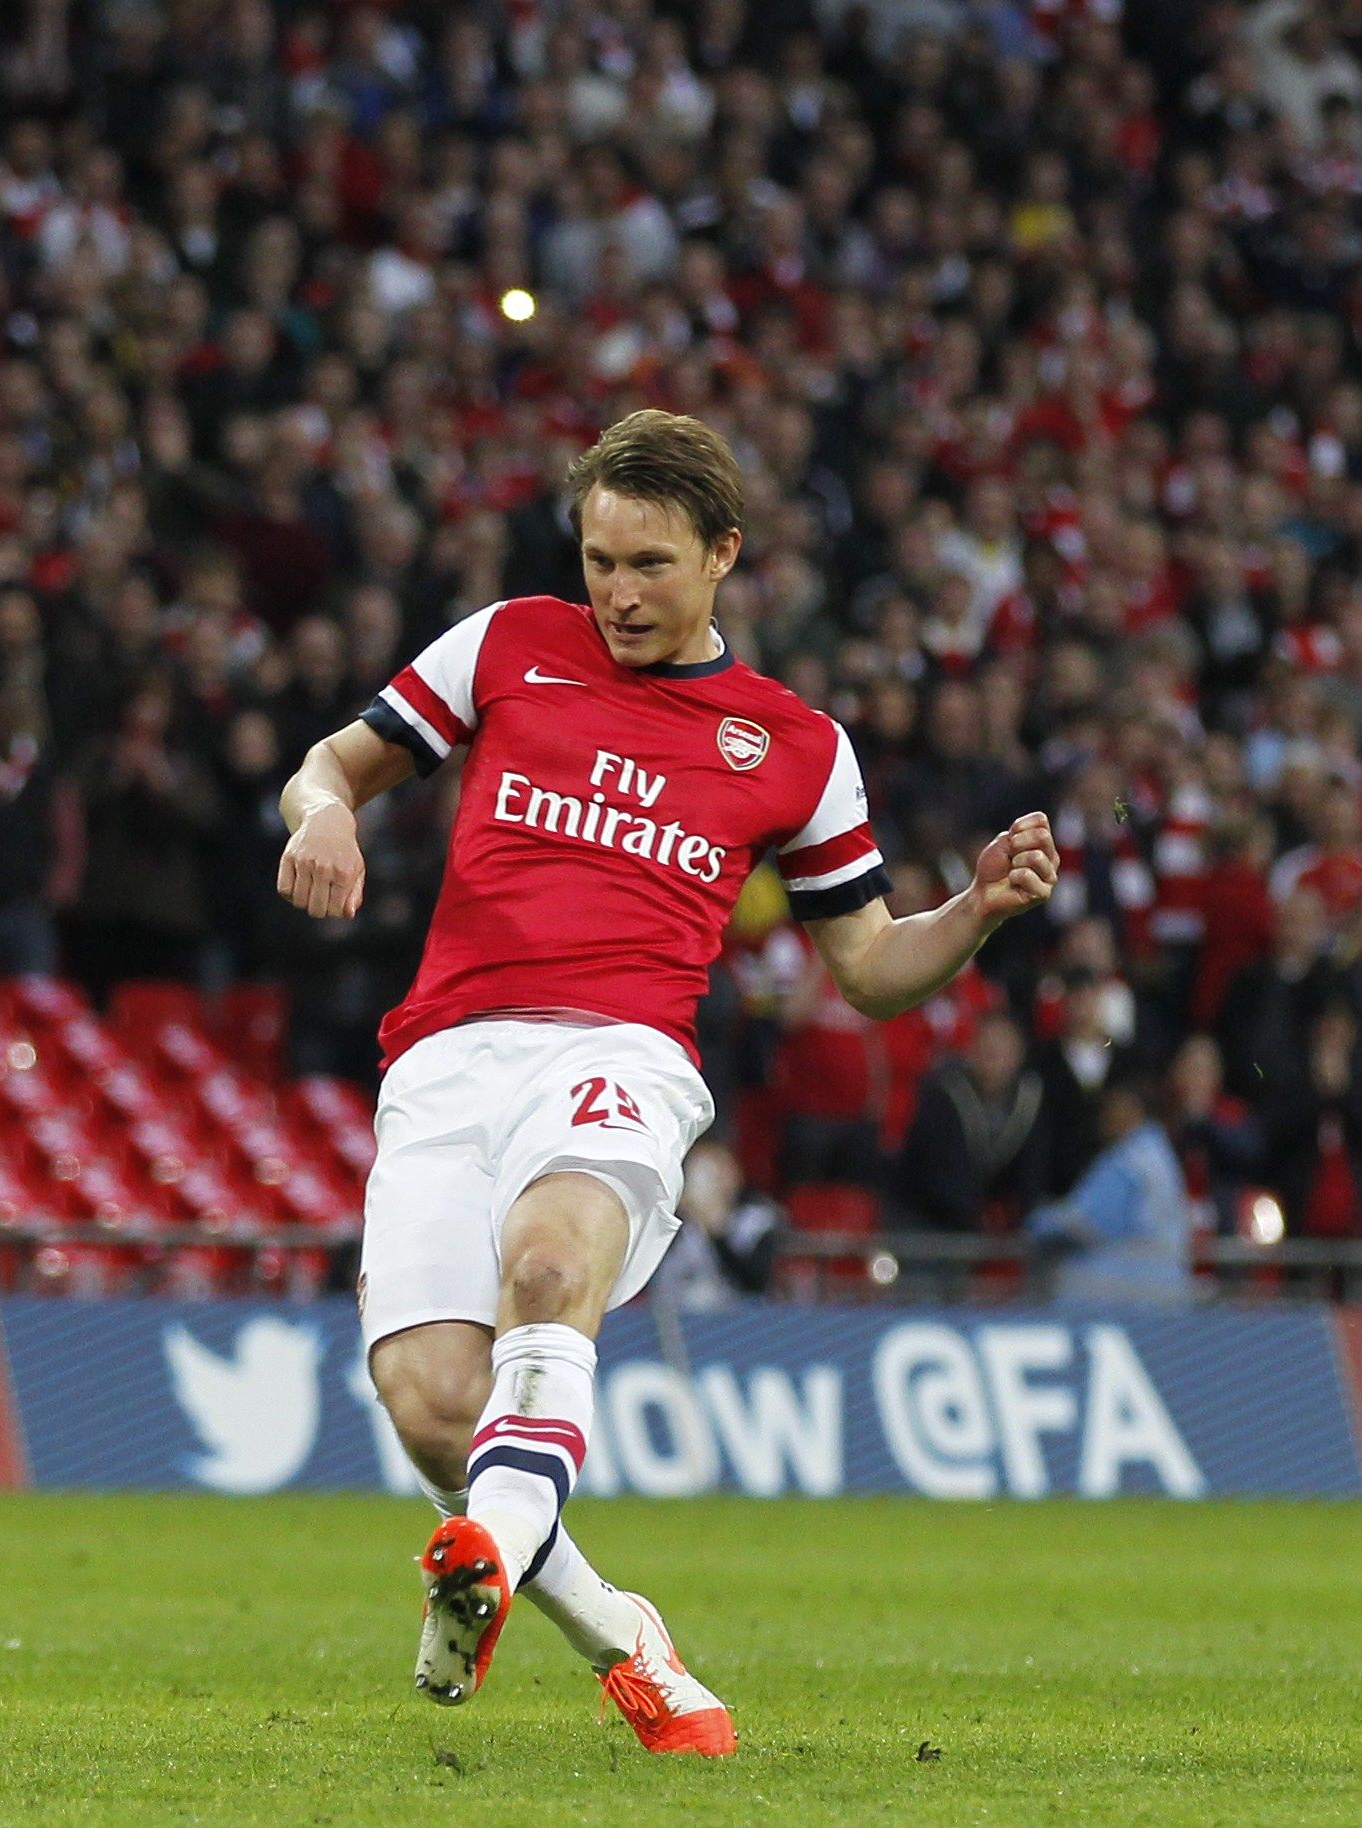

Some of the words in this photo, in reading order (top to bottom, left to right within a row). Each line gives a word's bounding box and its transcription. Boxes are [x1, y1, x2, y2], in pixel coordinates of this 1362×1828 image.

[493, 771, 727, 884] Emirates
[589, 749, 667, 808] Fly
[872, 1319, 1211, 1500] @FA
